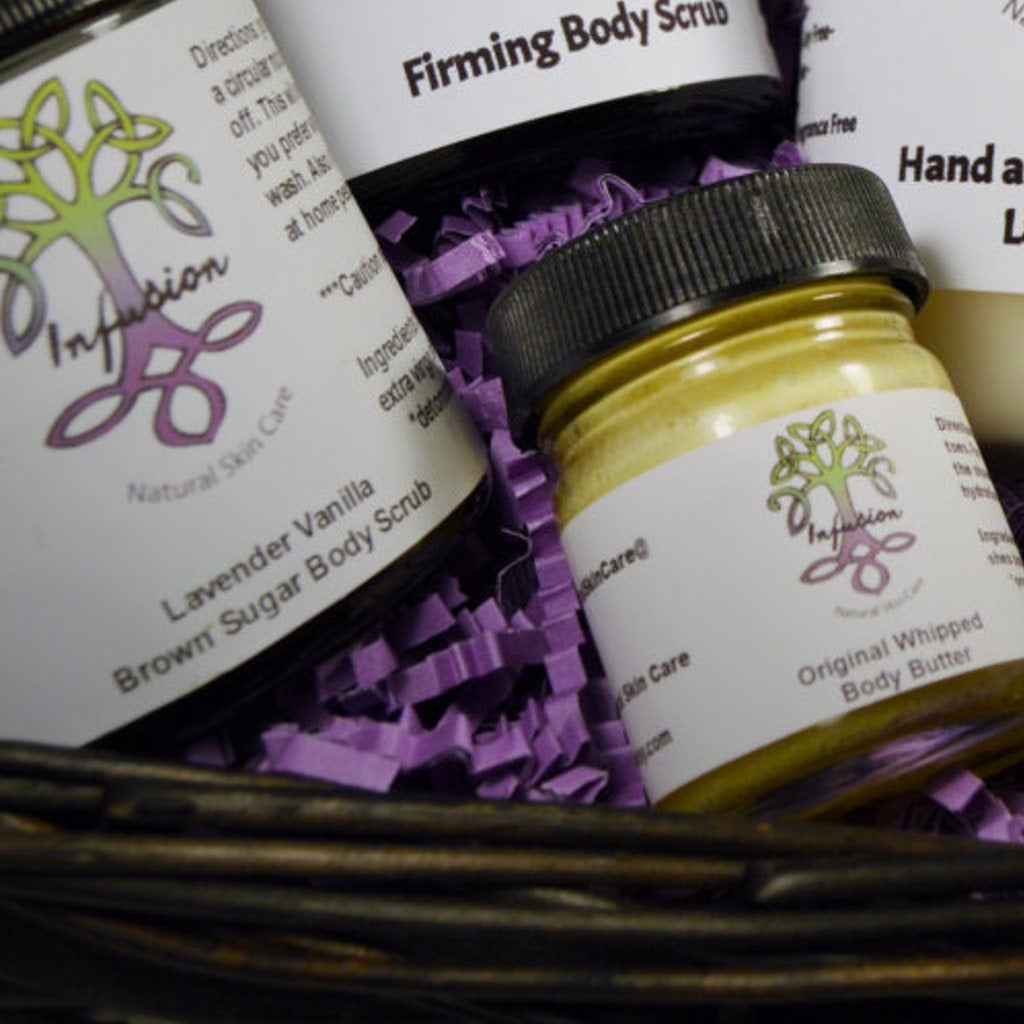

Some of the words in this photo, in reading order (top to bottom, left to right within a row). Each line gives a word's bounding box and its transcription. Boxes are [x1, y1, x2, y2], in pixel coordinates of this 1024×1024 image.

[403, 30, 560, 97] Firming
[560, 0, 649, 54] Body
[211, 84, 227, 105] a
[830, 112, 858, 135] Free
[246, 142, 281, 181] you
[898, 143, 996, 185] Hand
[284, 216, 305, 243] at
[48, 253, 229, 374] Infusion
[127, 466, 221, 505] Natural
[220, 437, 264, 477] Skin
[258, 384, 295, 436] Care
[160, 532, 294, 624] Lavender
[293, 475, 376, 540] Vanilla
[808, 506, 905, 553] Infusion
[112, 627, 216, 695] Brown
[219, 573, 304, 637] Sugar
[304, 524, 375, 583] Body
[373, 477, 435, 534] Scrub
[797, 638, 891, 687] Original
[893, 610, 984, 652] Whipped
[840, 668, 901, 703] Body
[907, 646, 973, 680] Butter
[621, 674, 649, 704] Skin
[648, 650, 692, 685] Care
